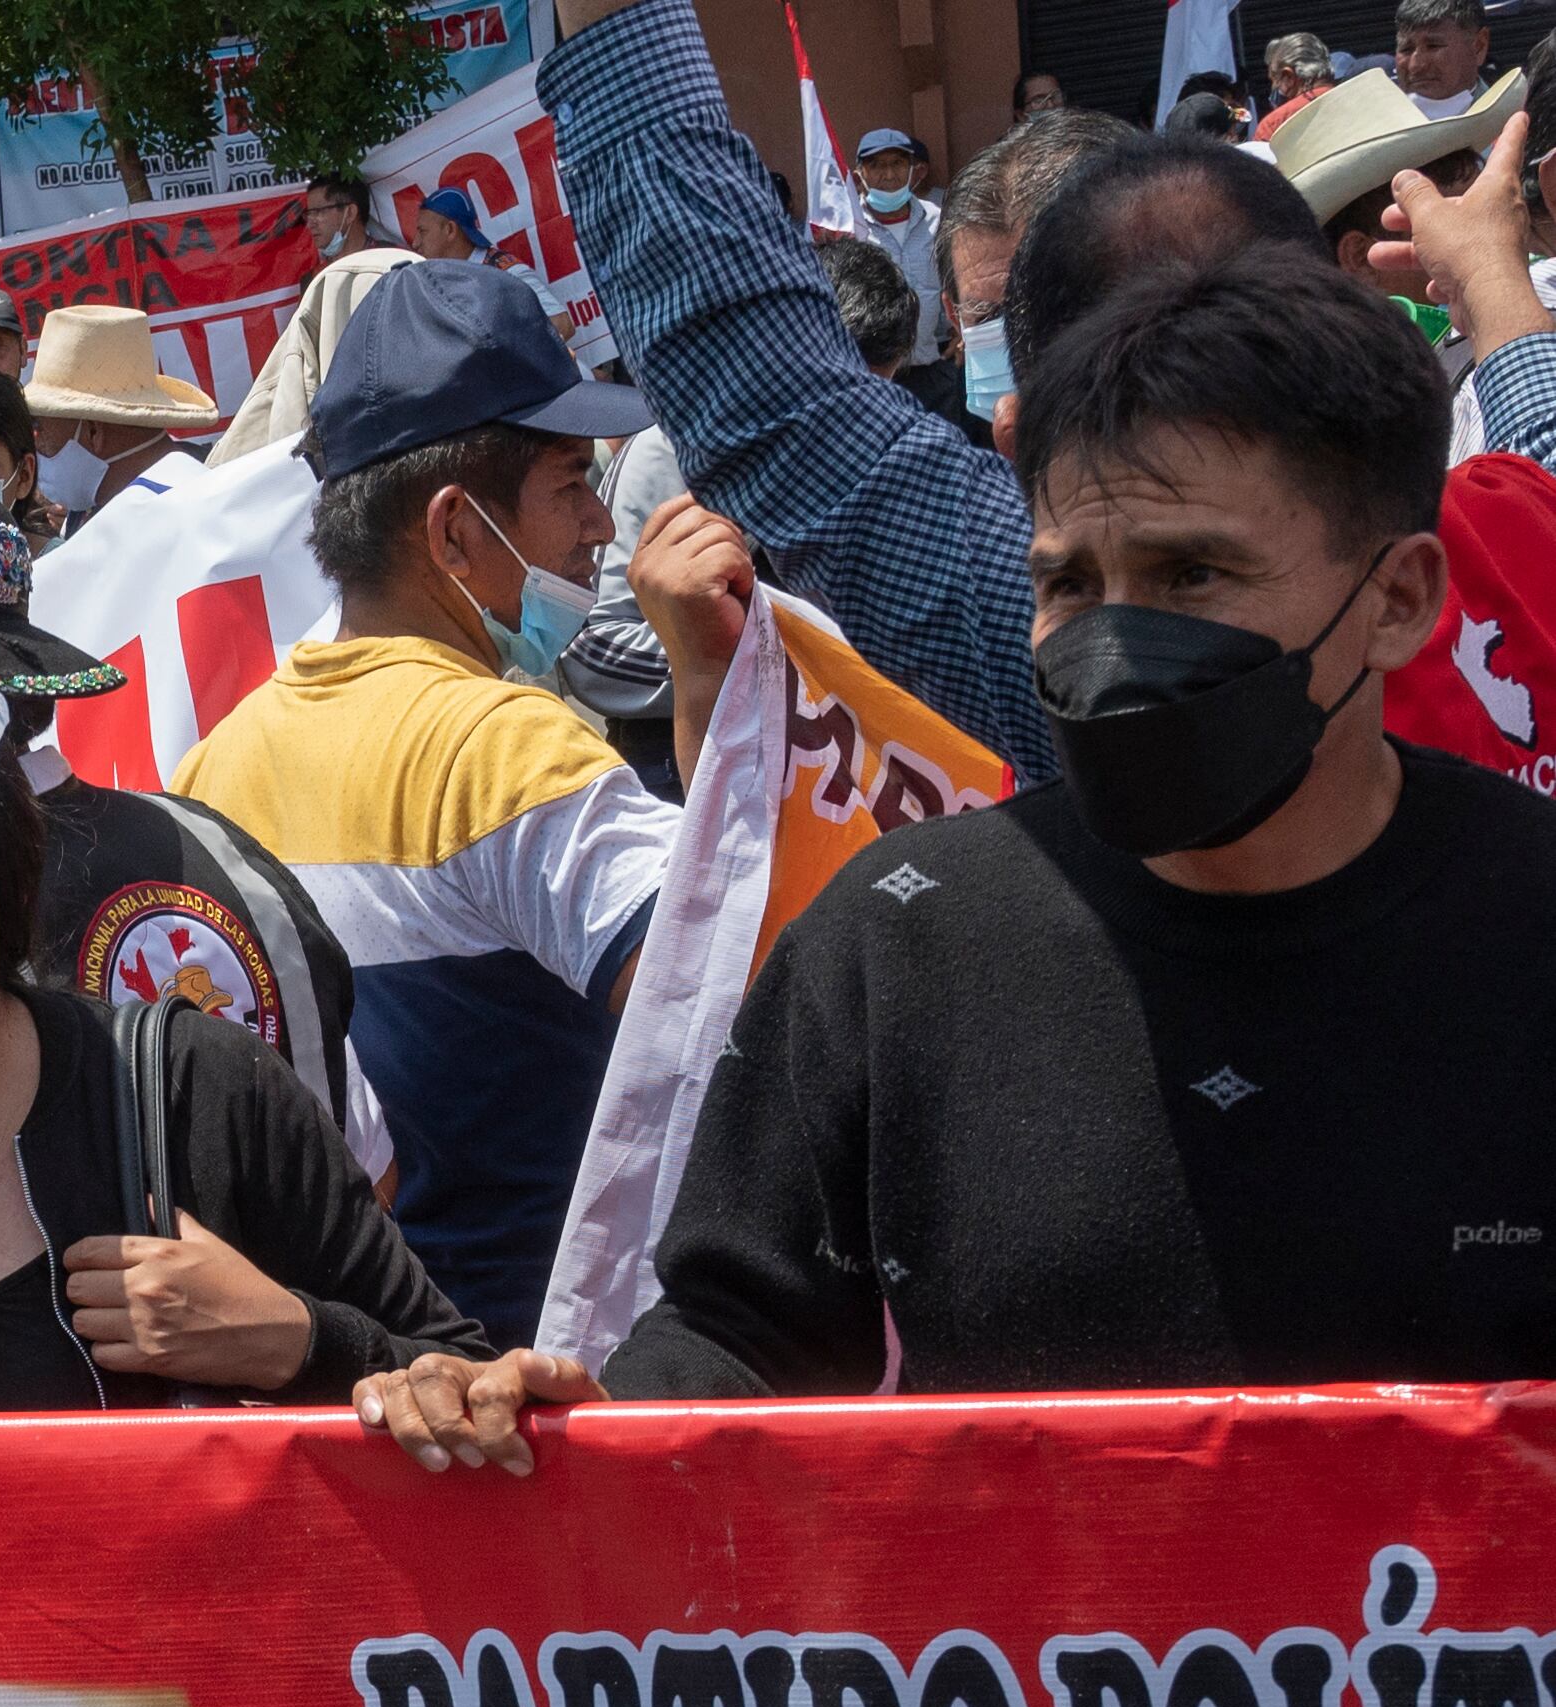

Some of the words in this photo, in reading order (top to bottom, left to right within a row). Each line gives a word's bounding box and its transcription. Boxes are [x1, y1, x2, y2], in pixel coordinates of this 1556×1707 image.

[82, 161, 120, 182] GOLP
[85, 918, 117, 993] NACIONAL
[106, 893, 140, 926] PARA
[138, 888, 156, 907] LA
[155, 887, 203, 912] UNIDAD
[206, 901, 223, 924] DE
[223, 915, 246, 945] LAS
[243, 942, 275, 1008] RONDAS
[265, 1013, 277, 1045] ERU
